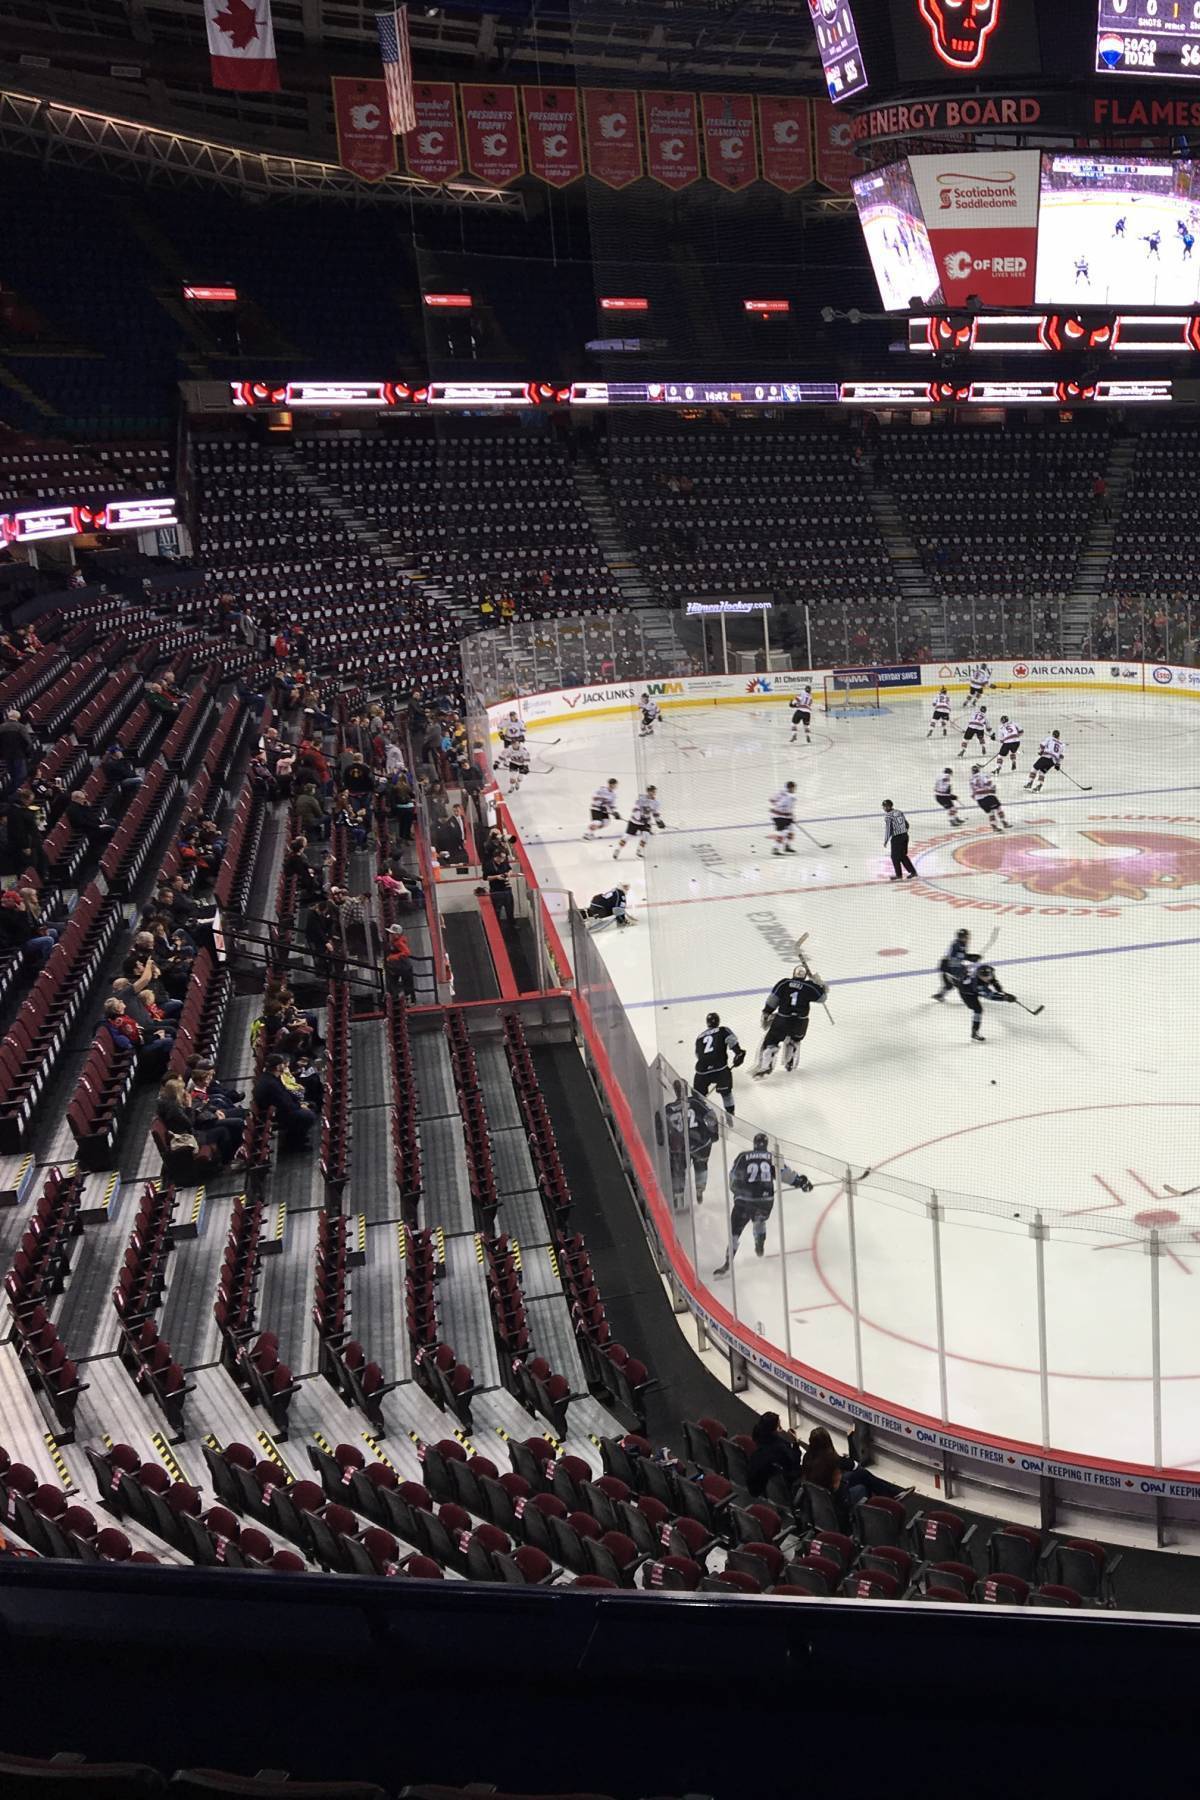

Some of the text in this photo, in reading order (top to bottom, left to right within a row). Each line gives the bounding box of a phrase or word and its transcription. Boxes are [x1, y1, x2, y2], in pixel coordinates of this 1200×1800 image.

[1124, 38, 1157, 53] 50/50
[1124, 52, 1155, 66] TOTAL
[870, 99, 1041, 135] ENERGY BOARD
[477, 121, 507, 130] TROPHY
[539, 122, 568, 132] TROPHY
[954, 186, 1016, 199] Scotiabank
[955, 198, 1017, 209] Saddledome
[973, 259, 991, 270] OF
[992, 257, 1027, 271] RED
[686, 601, 771, 615] HitmenHockey.com
[900, 670, 918, 680] SAVES
[1031, 665, 1095, 676] AIR CANADA
[646, 682, 683, 695] WM
[582, 691, 604, 704] JACK
[893, 883, 1121, 917] Scotiabank
[790, 991, 798, 1006] 1
[703, 1035, 714, 1053] 2
[847, 1402, 873, 1421] KEEPING
[873, 1414, 881, 1425] IT
[882, 1416, 902, 1433] FRESH
[916, 1430, 1004, 1463] OPA! KEEPING IT FRESH
[1021, 1459, 1121, 1488] OPA! KEEPING IT FRESH
[1140, 1481, 1166, 1494] OPA!
